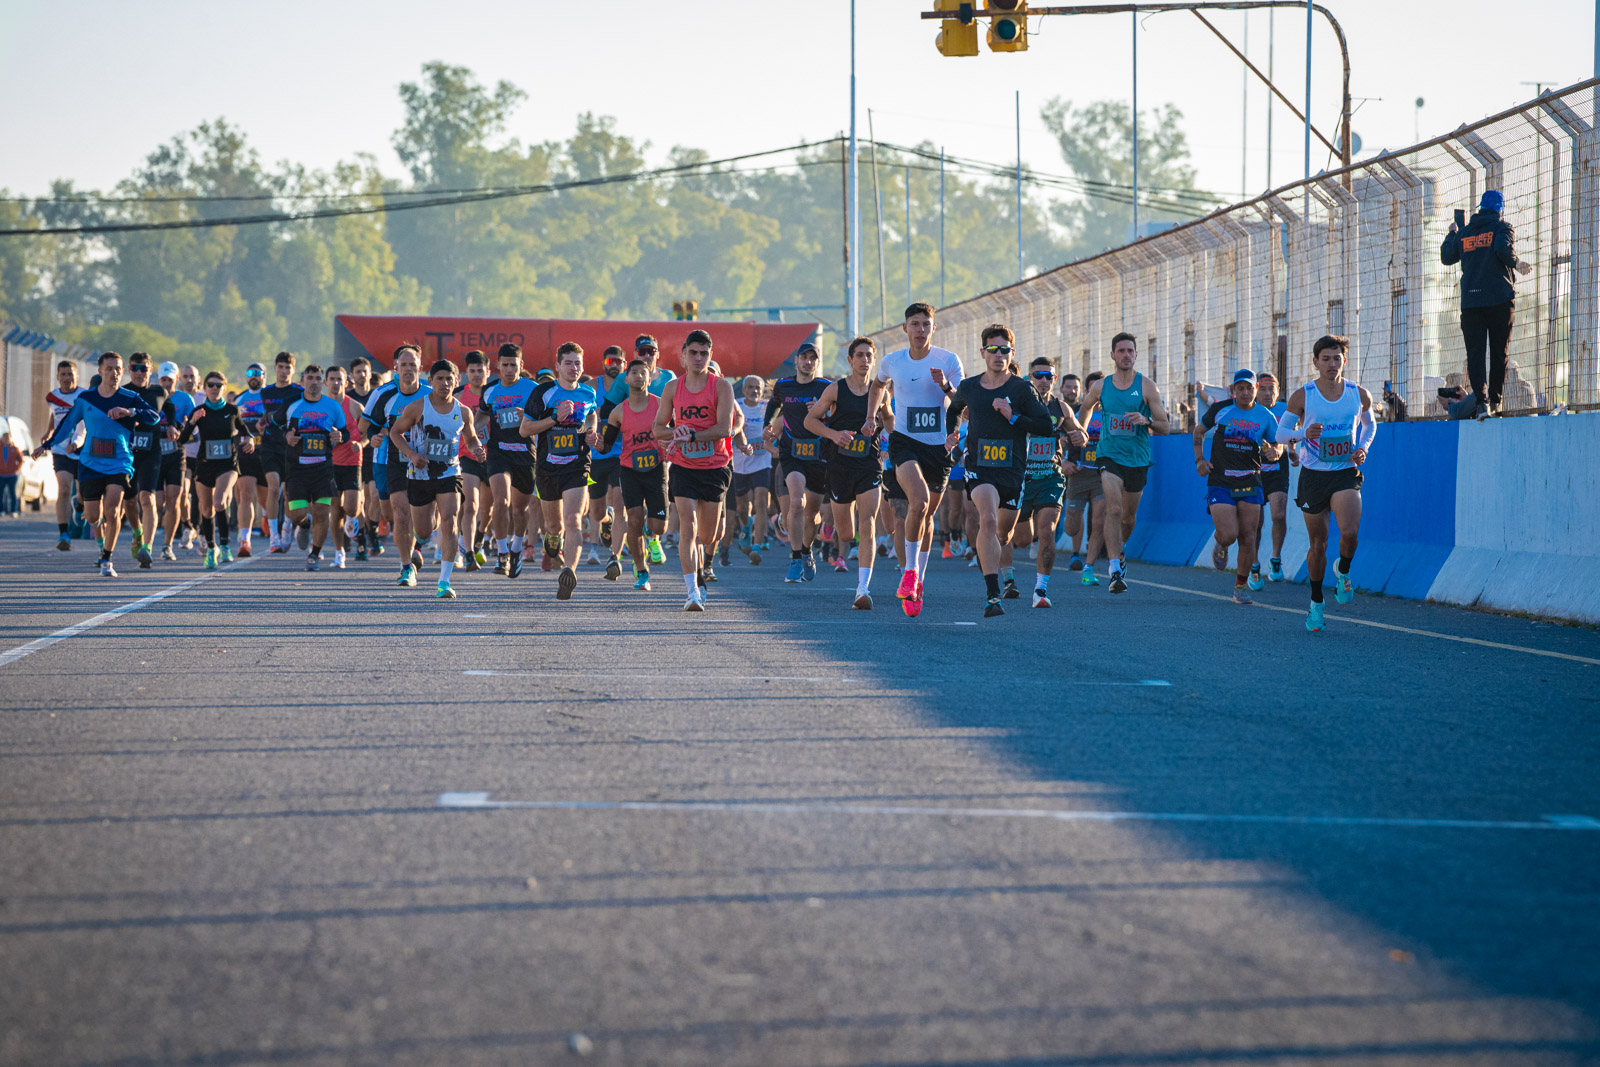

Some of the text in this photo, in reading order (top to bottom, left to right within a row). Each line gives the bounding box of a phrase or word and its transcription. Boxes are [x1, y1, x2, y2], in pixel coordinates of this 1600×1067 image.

[502, 411, 519, 424] 105
[915, 413, 936, 427] 106
[1112, 419, 1131, 430] 344
[133, 436, 149, 448] 167
[307, 439, 324, 450] 756
[554, 435, 573, 448] 707
[213, 444, 225, 455] 21
[429, 443, 449, 456] 174
[796, 443, 814, 456] 782
[983, 446, 1007, 460] 706
[1033, 443, 1051, 455] 317
[1328, 441, 1349, 456] 303
[637, 455, 656, 468] 712
